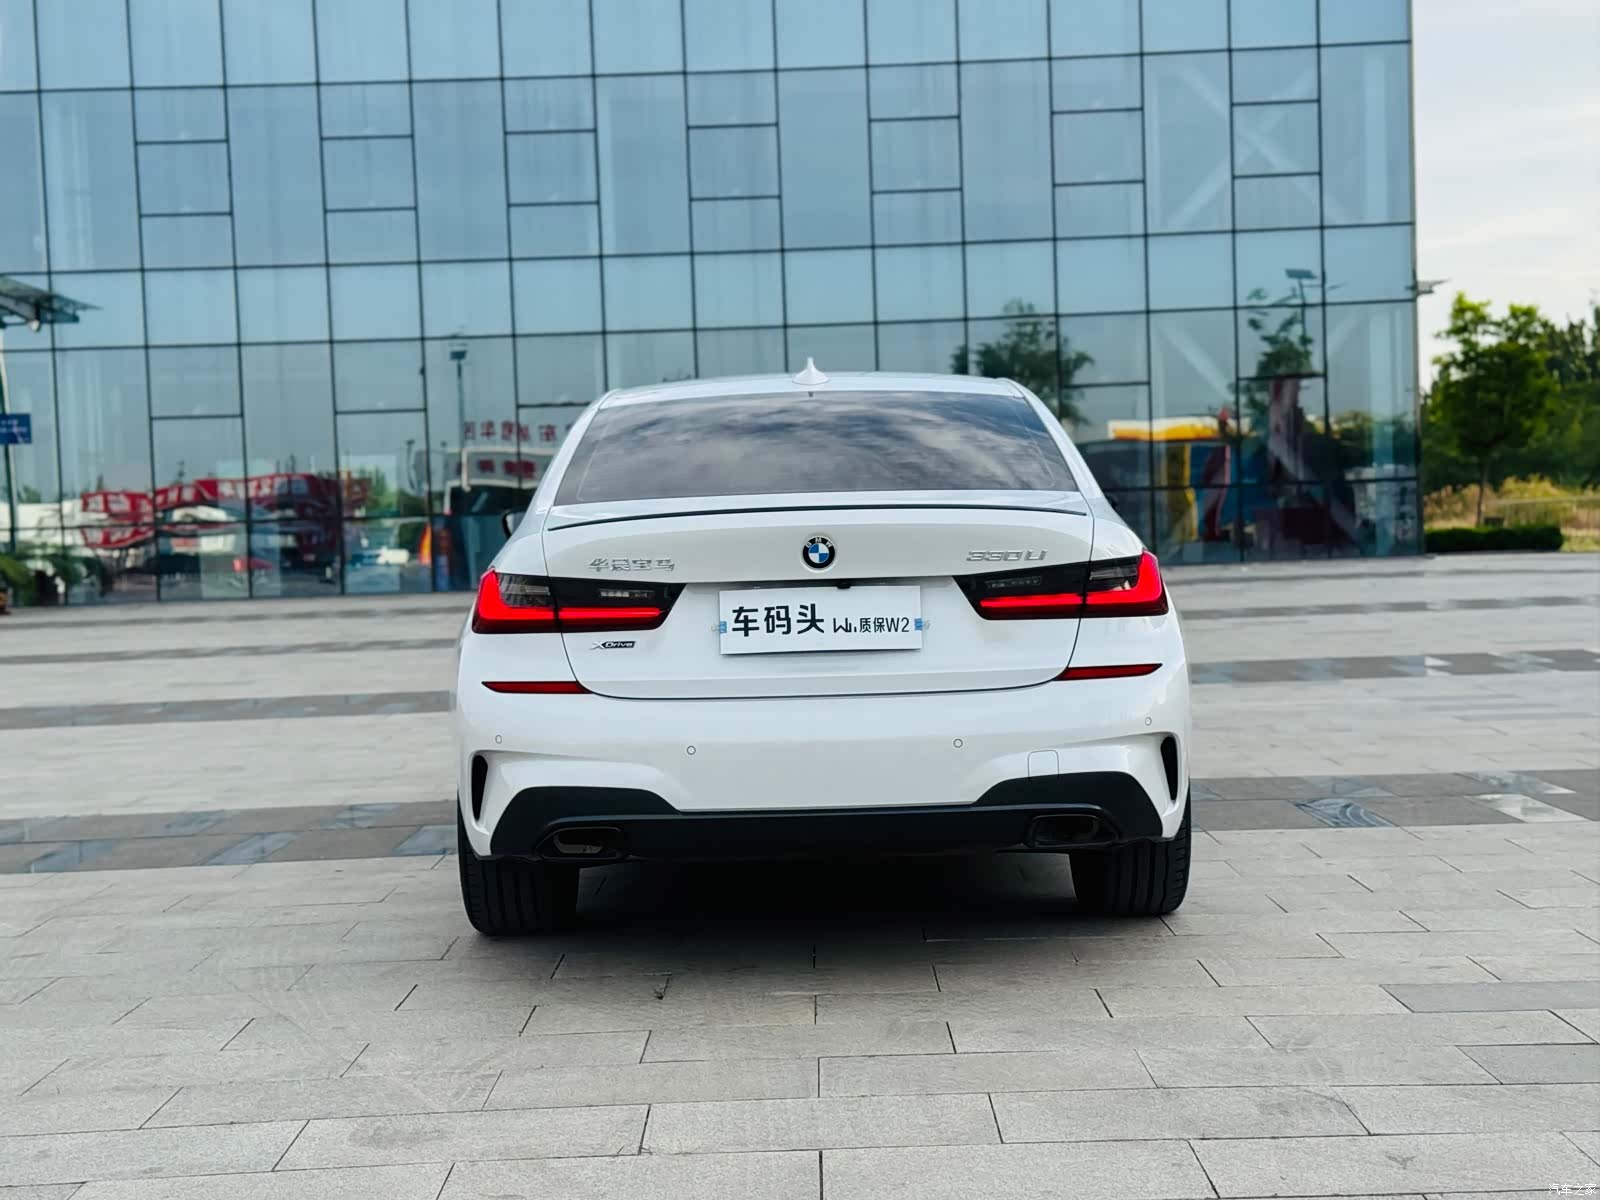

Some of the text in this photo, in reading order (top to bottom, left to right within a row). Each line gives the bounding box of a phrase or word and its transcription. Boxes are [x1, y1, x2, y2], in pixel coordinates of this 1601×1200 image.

[805, 537, 833, 548] BMW
[588, 558, 675, 572] 华晨宝马
[732, 603, 825, 637] 车码头
